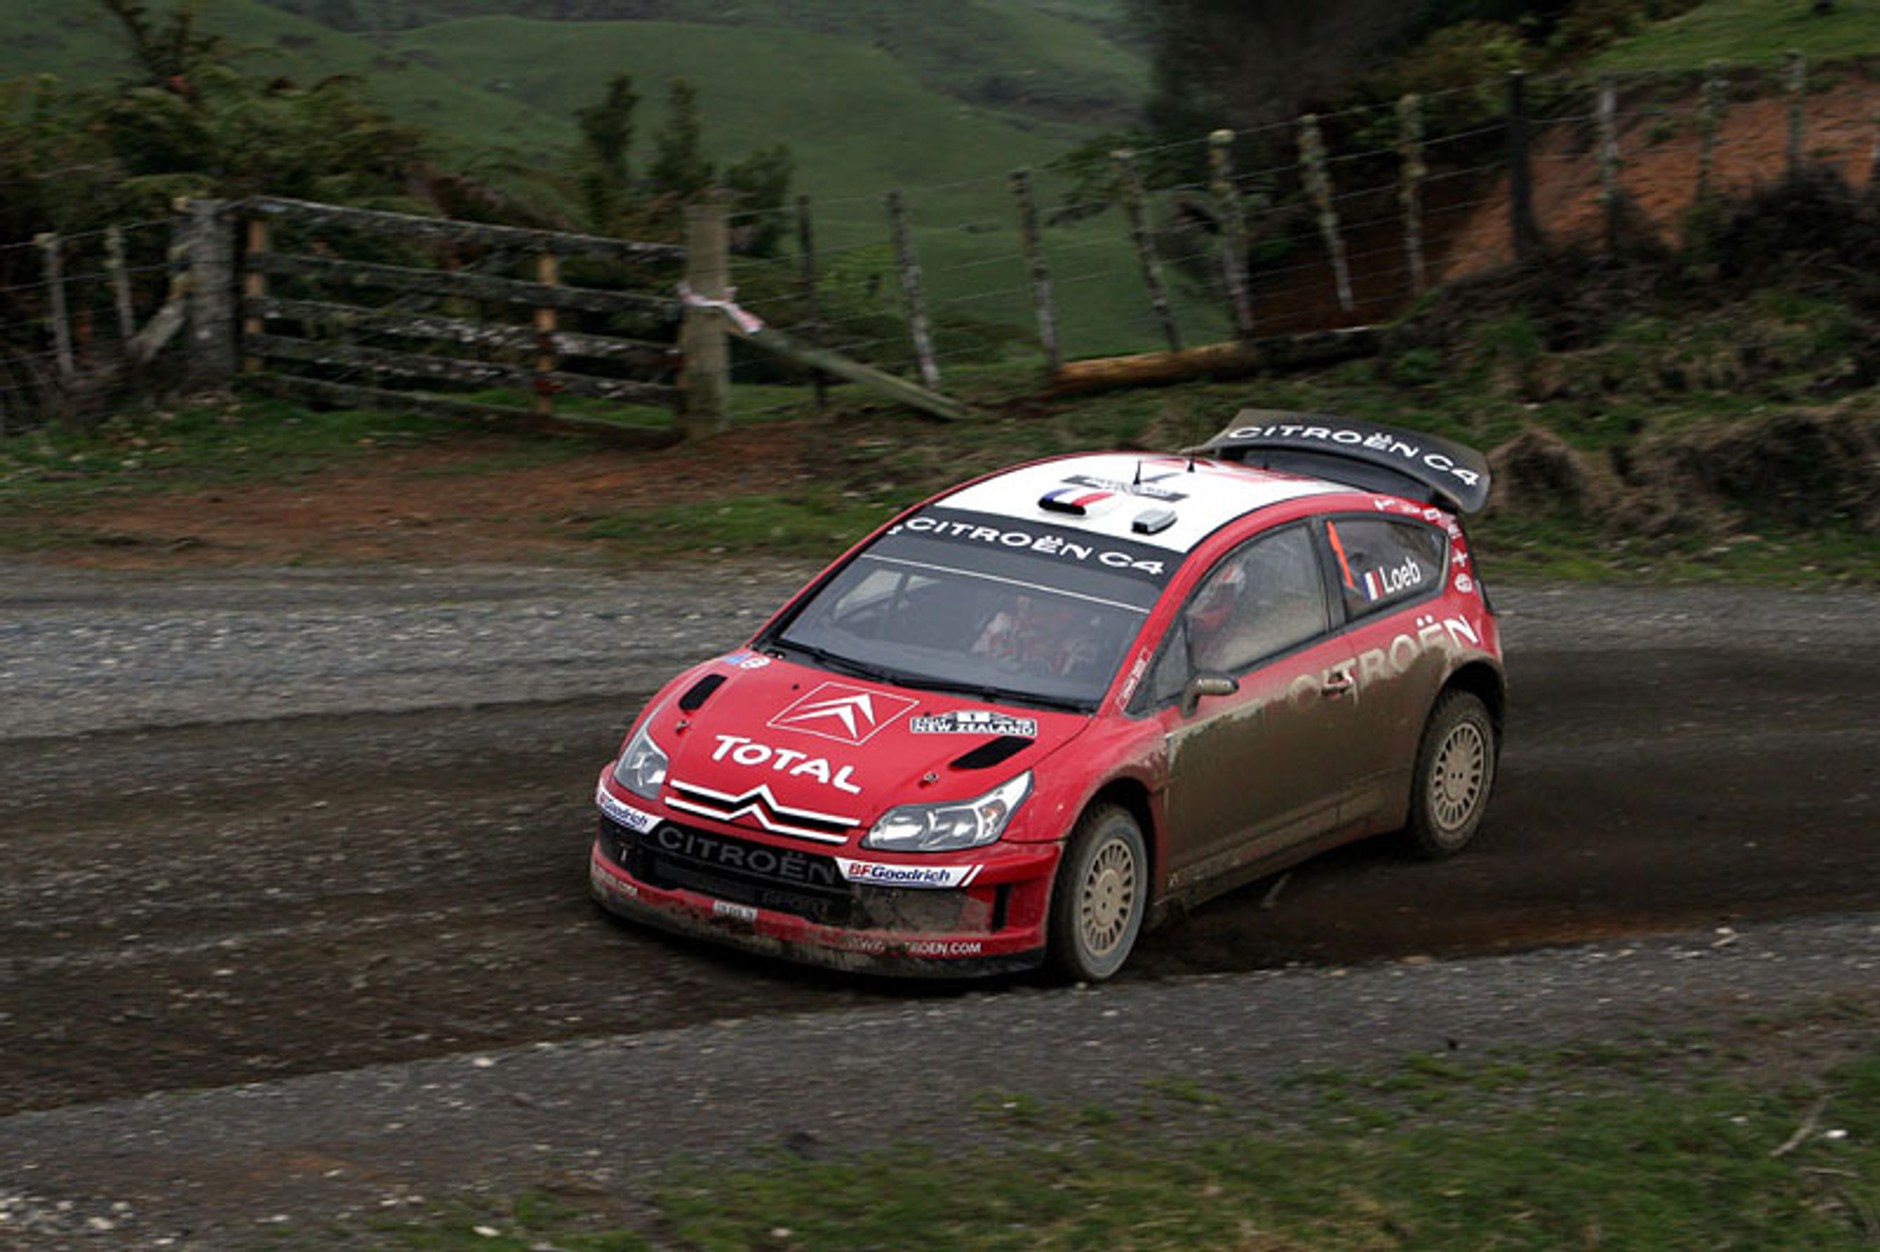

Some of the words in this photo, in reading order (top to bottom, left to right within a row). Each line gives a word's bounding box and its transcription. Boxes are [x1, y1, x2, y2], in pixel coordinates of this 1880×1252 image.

[1229, 425, 1419, 457] CITROËN
[1423, 454, 1480, 486] C4
[906, 516, 1093, 559] CITROËN
[1099, 552, 1165, 574] C4
[1379, 556, 1420, 594] Loeb
[916, 721, 952, 733] NEW
[957, 723, 1033, 736] ZEALAND
[712, 735, 861, 793] TOTAL
[657, 826, 837, 885] CITROËN
[848, 862, 951, 882] BFGoodrich
